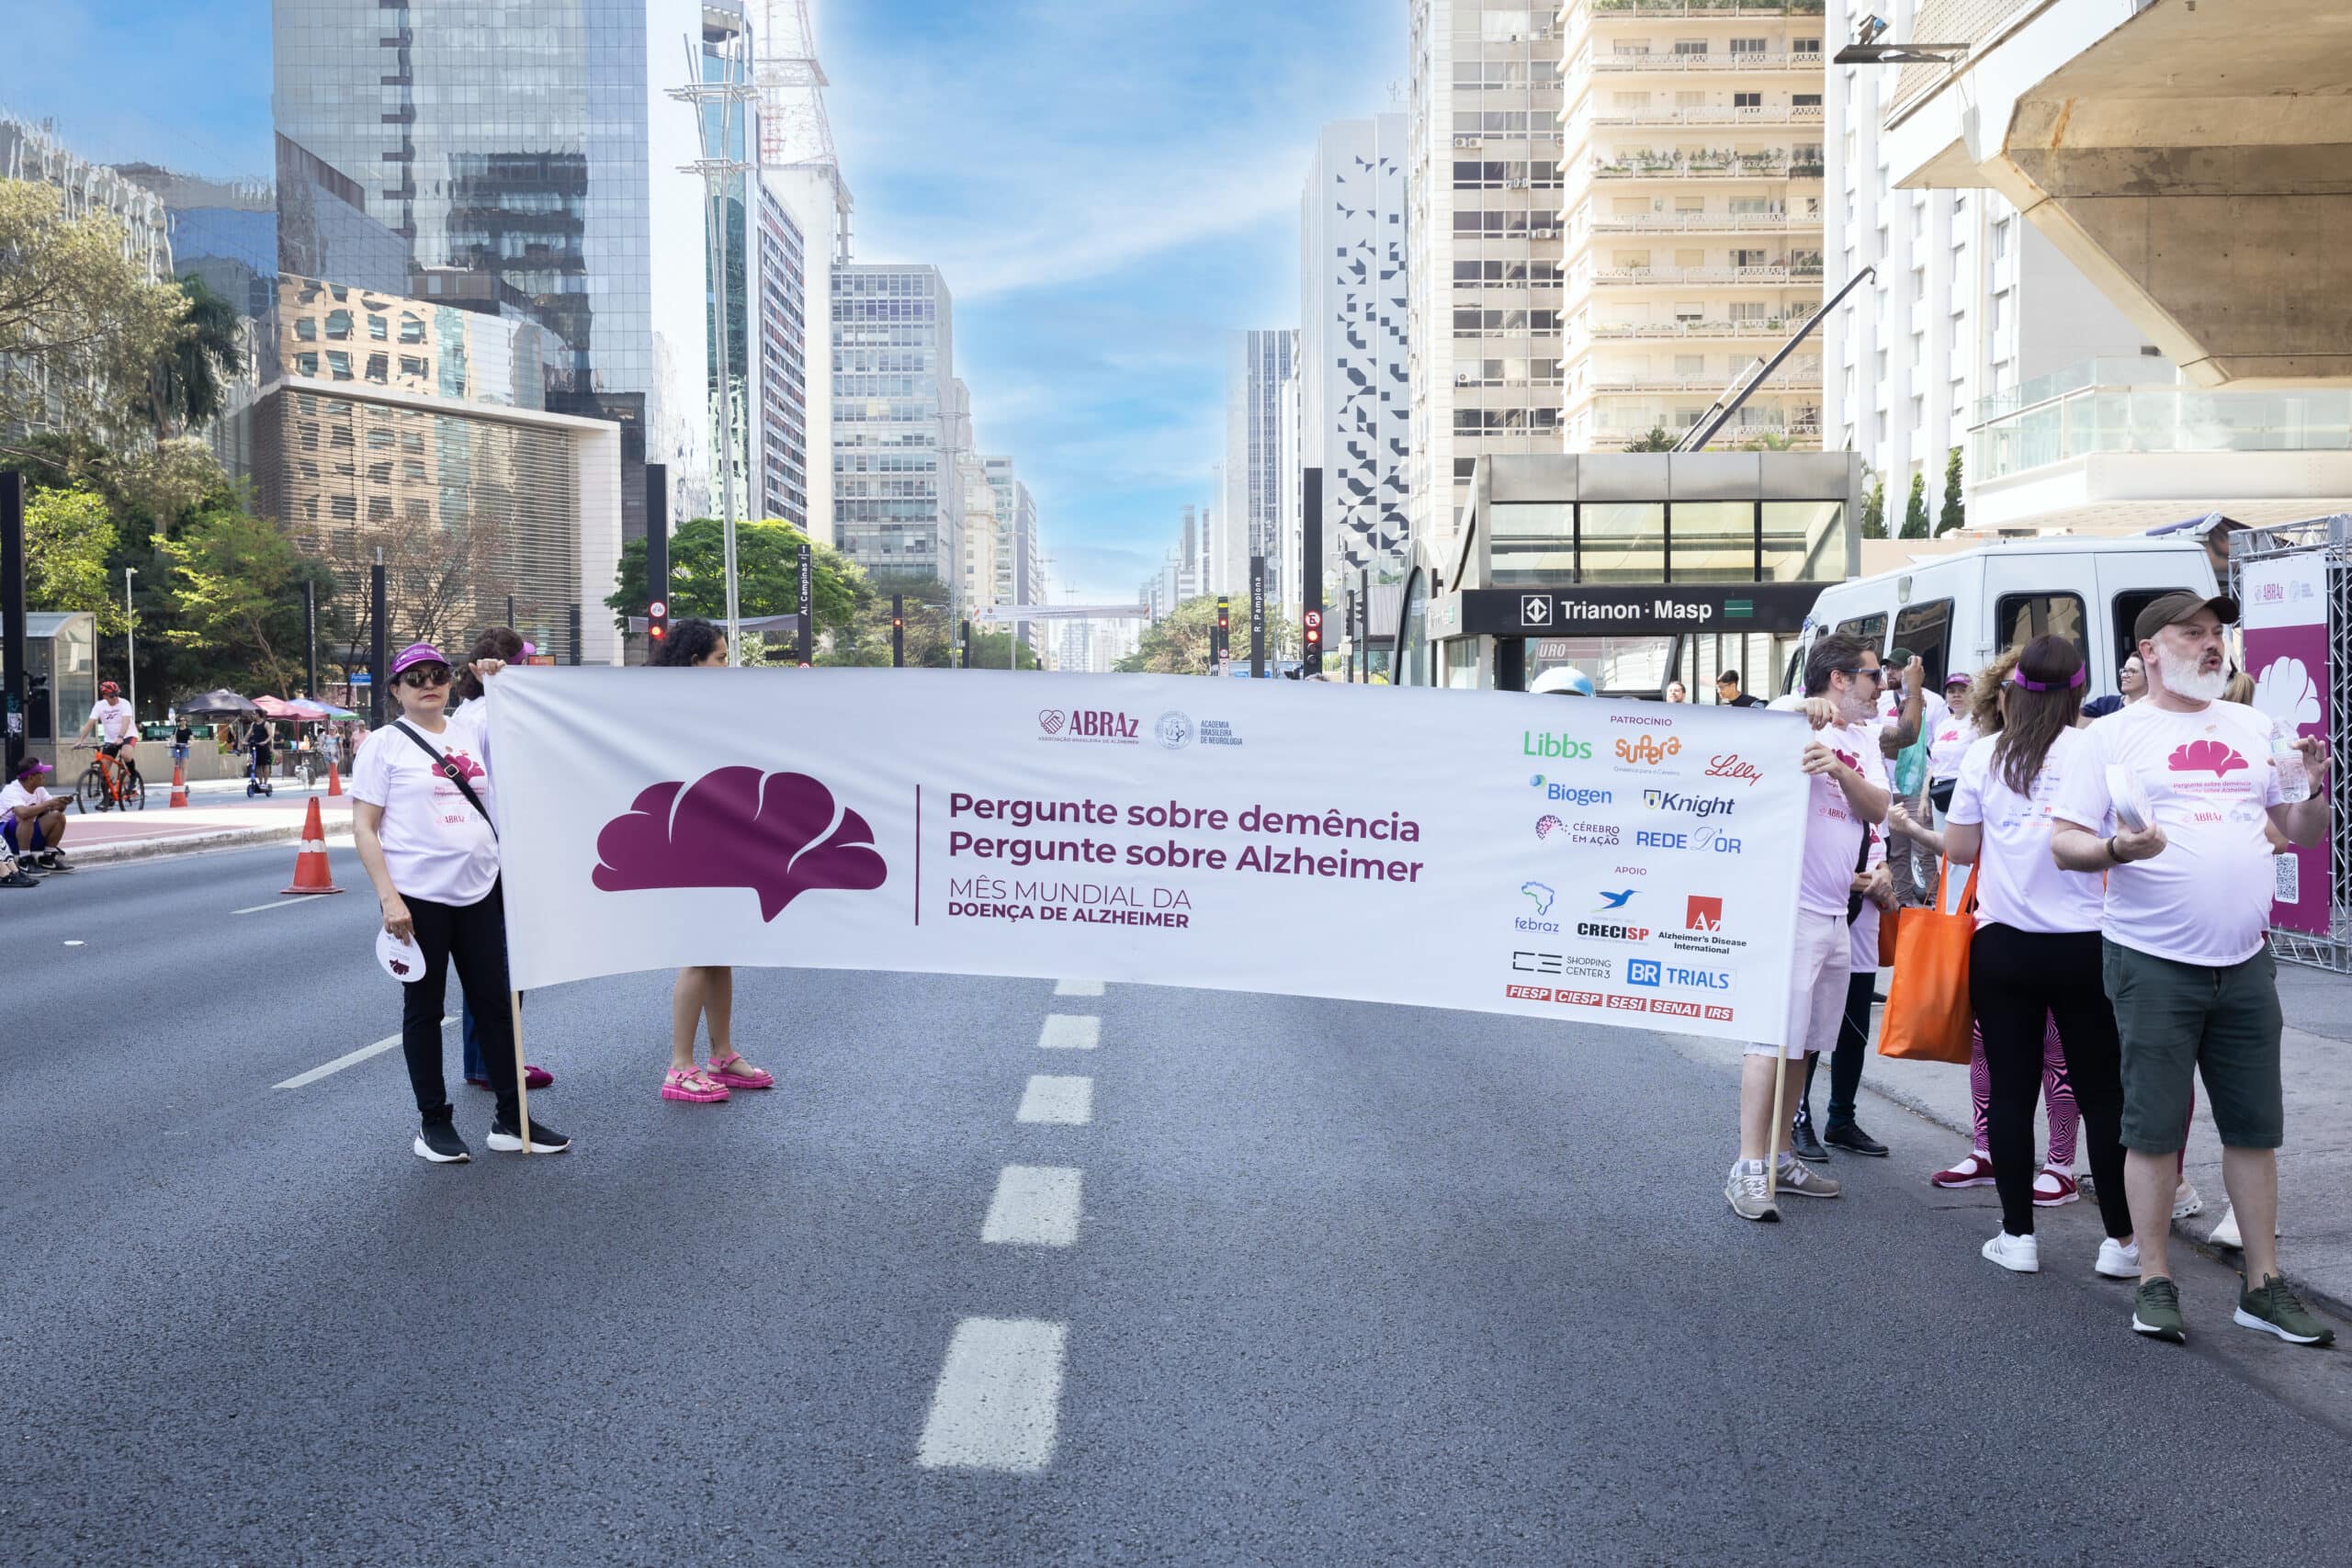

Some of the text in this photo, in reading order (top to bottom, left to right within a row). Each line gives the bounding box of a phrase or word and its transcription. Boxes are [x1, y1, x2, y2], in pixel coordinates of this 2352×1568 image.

[800, 562, 808, 602] Campinas
[1254, 577, 1262, 632] R. Pamplona
[1561, 600, 1713, 623] Trianon Masp
[1539, 643, 1566, 658] URO
[1201, 720, 1229, 728] ACADEMIA
[1611, 716, 1672, 727] PATROCÍNIO
[1201, 728, 1232, 737] BRASILEIRA
[1208, 738, 1243, 746] NEUROLOGIA
[1523, 731, 1592, 760] Libbs
[1704, 754, 1764, 786] Lilly
[1548, 784, 1612, 807] Biogen
[1661, 793, 1736, 818] Knight
[949, 793, 1420, 842] Pergunte sobre demência
[1573, 820, 1620, 836] CÉREBRO
[1572, 832, 1620, 847] EM AÇÃO
[1636, 830, 1688, 849] REDE
[949, 831, 1424, 882] Pergunte sobre Alzheimer
[1614, 866, 1647, 875] APOIO
[950, 874, 1192, 910] MÊS MUNDIAL DA
[948, 901, 1189, 929] DOENÇA DE ALZHEIMER
[1515, 917, 1559, 933] febraz
[1577, 922, 1650, 941] CRECISP
[1657, 931, 1709, 944] Alzheimer's
[1712, 937, 1747, 947] Disease
[1674, 942, 1730, 955] International
[1566, 956, 1611, 968] SHOPPING
[1566, 966, 1603, 978] CENTER
[1631, 964, 1729, 989] BR TRIALS
[1510, 987, 1731, 1020] FIESP CIESP SESI SENAI IRS
